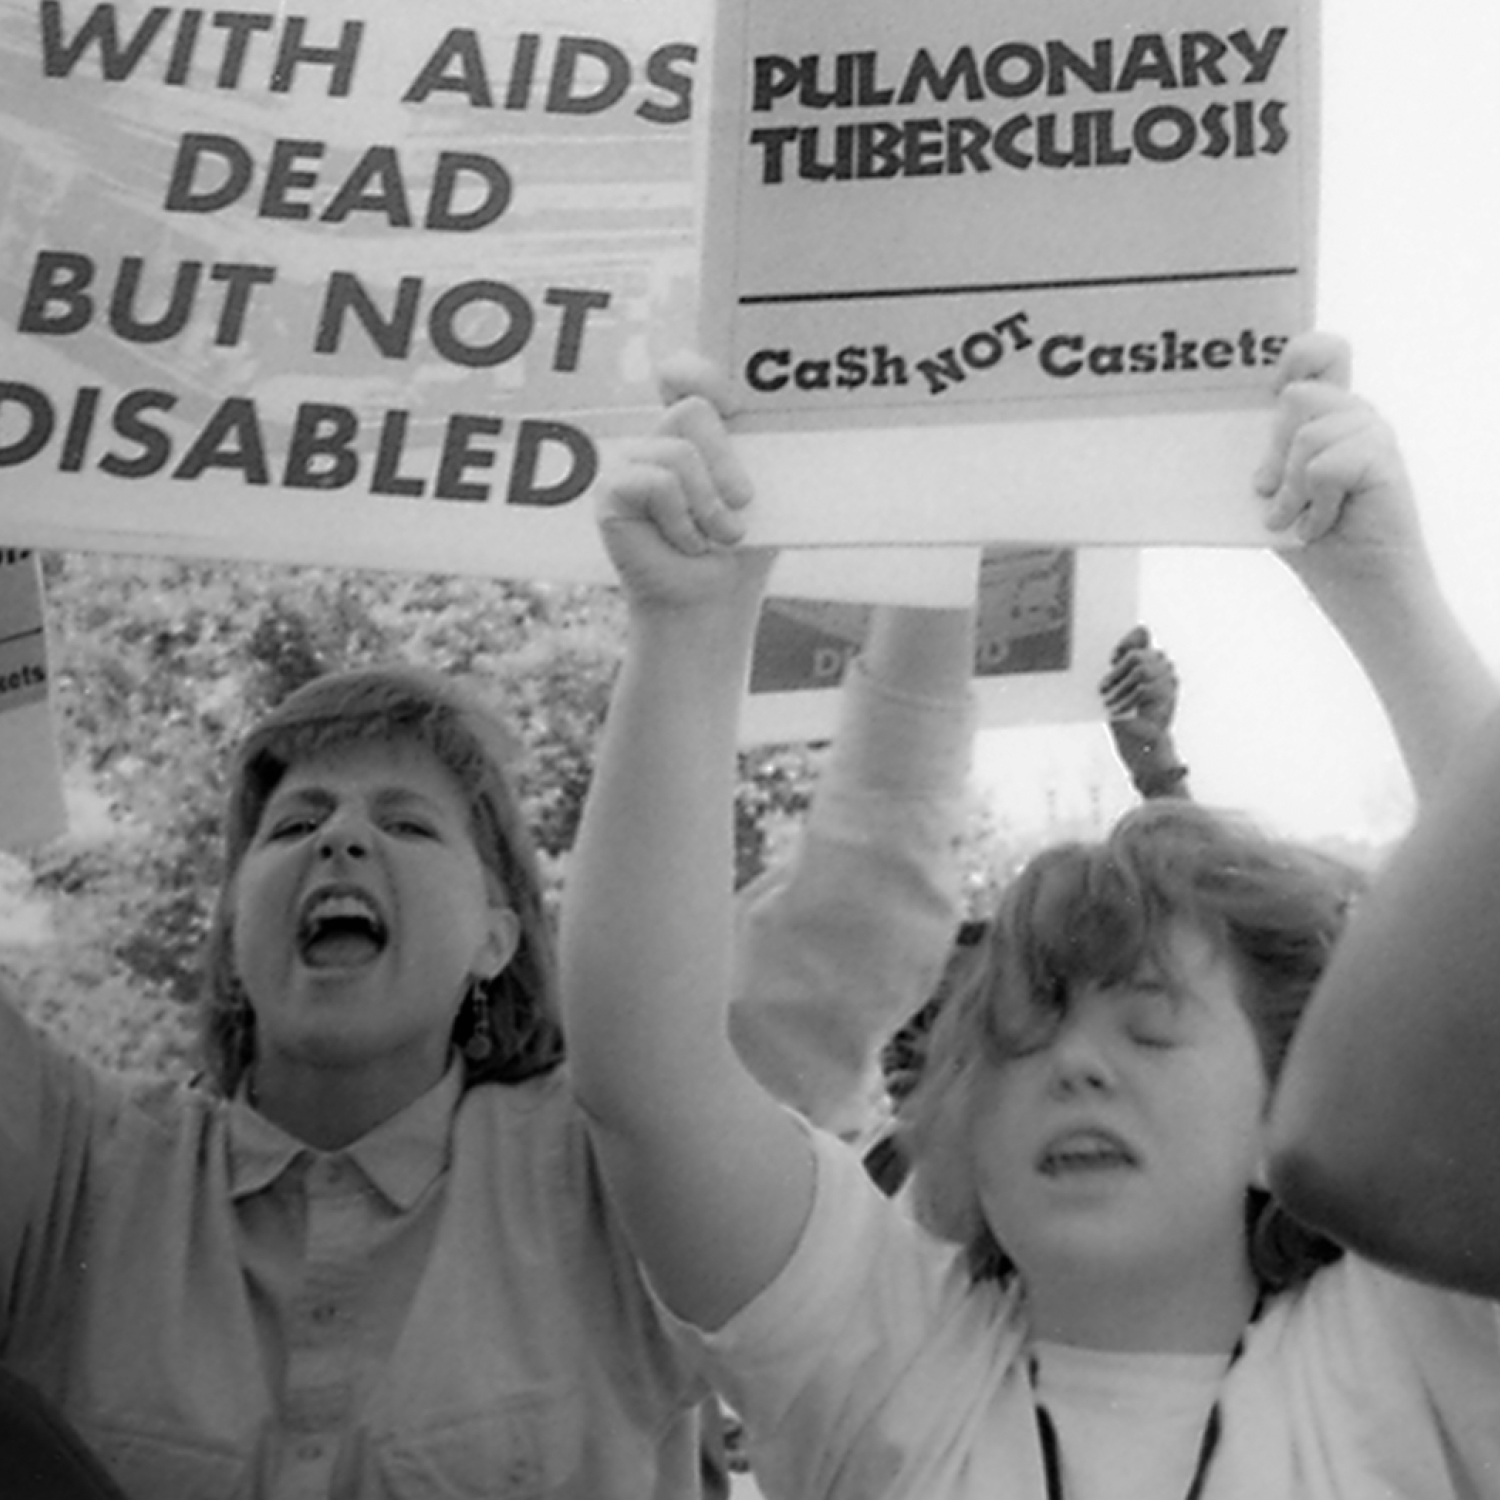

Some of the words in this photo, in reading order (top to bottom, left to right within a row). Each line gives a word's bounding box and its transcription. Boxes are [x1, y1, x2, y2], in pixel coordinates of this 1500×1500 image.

[400, 27, 698, 126] AIDS
[751, 26, 1289, 111] PULMONARY
[164, 131, 513, 233] DEAD
[749, 99, 1290, 185] TUBERCULOSIS
[17, 249, 276, 348] BUT
[313, 270, 612, 373] NOT
[915, 310, 1033, 396] NOT
[1039, 328, 1289, 379] Caskets
[0, 380, 599, 507] DISABLED
